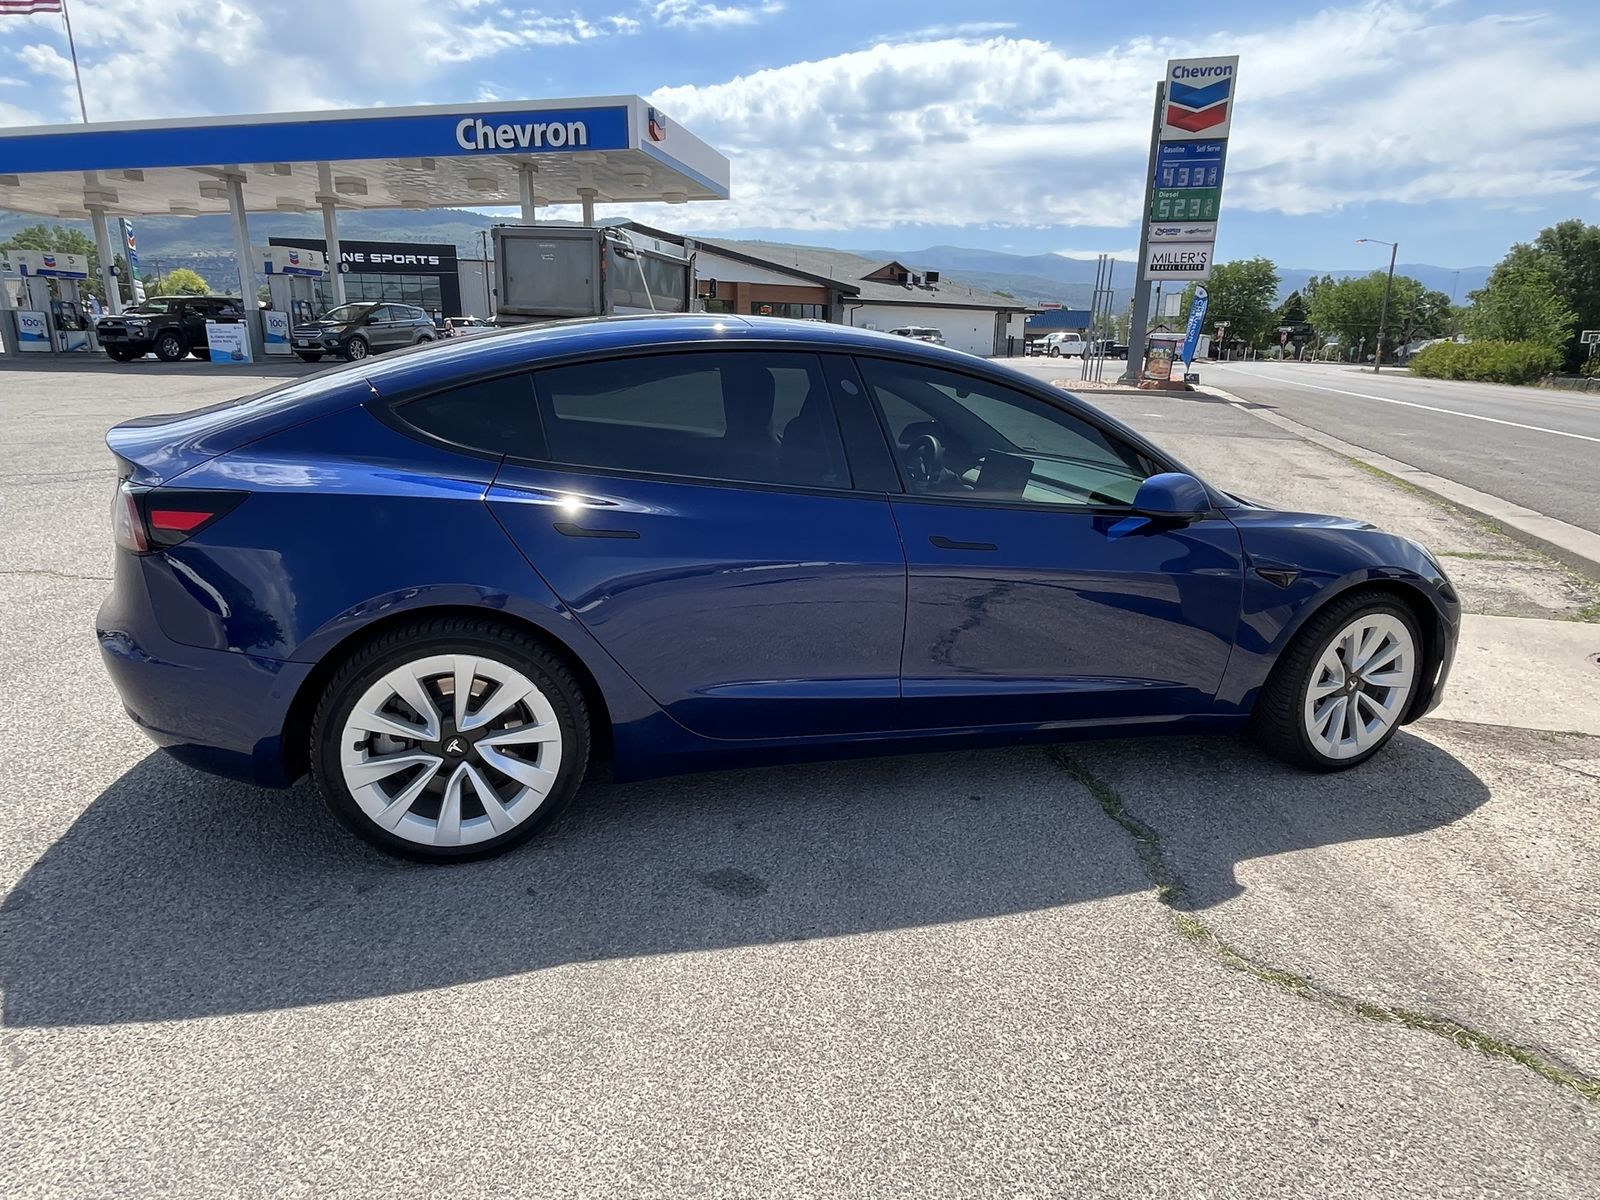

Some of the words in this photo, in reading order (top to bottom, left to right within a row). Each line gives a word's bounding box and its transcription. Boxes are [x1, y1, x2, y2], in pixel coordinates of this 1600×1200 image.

[1172, 65, 1232, 79] Chevron
[456, 118, 587, 149] Chevron
[1163, 146, 1186, 154] Gasoline
[1196, 145, 1206, 153] Self
[67, 256, 75, 264] 5
[307, 252, 314, 262] 3
[370, 253, 440, 265] SPORTS
[1151, 252, 1208, 264] MILLER'S
